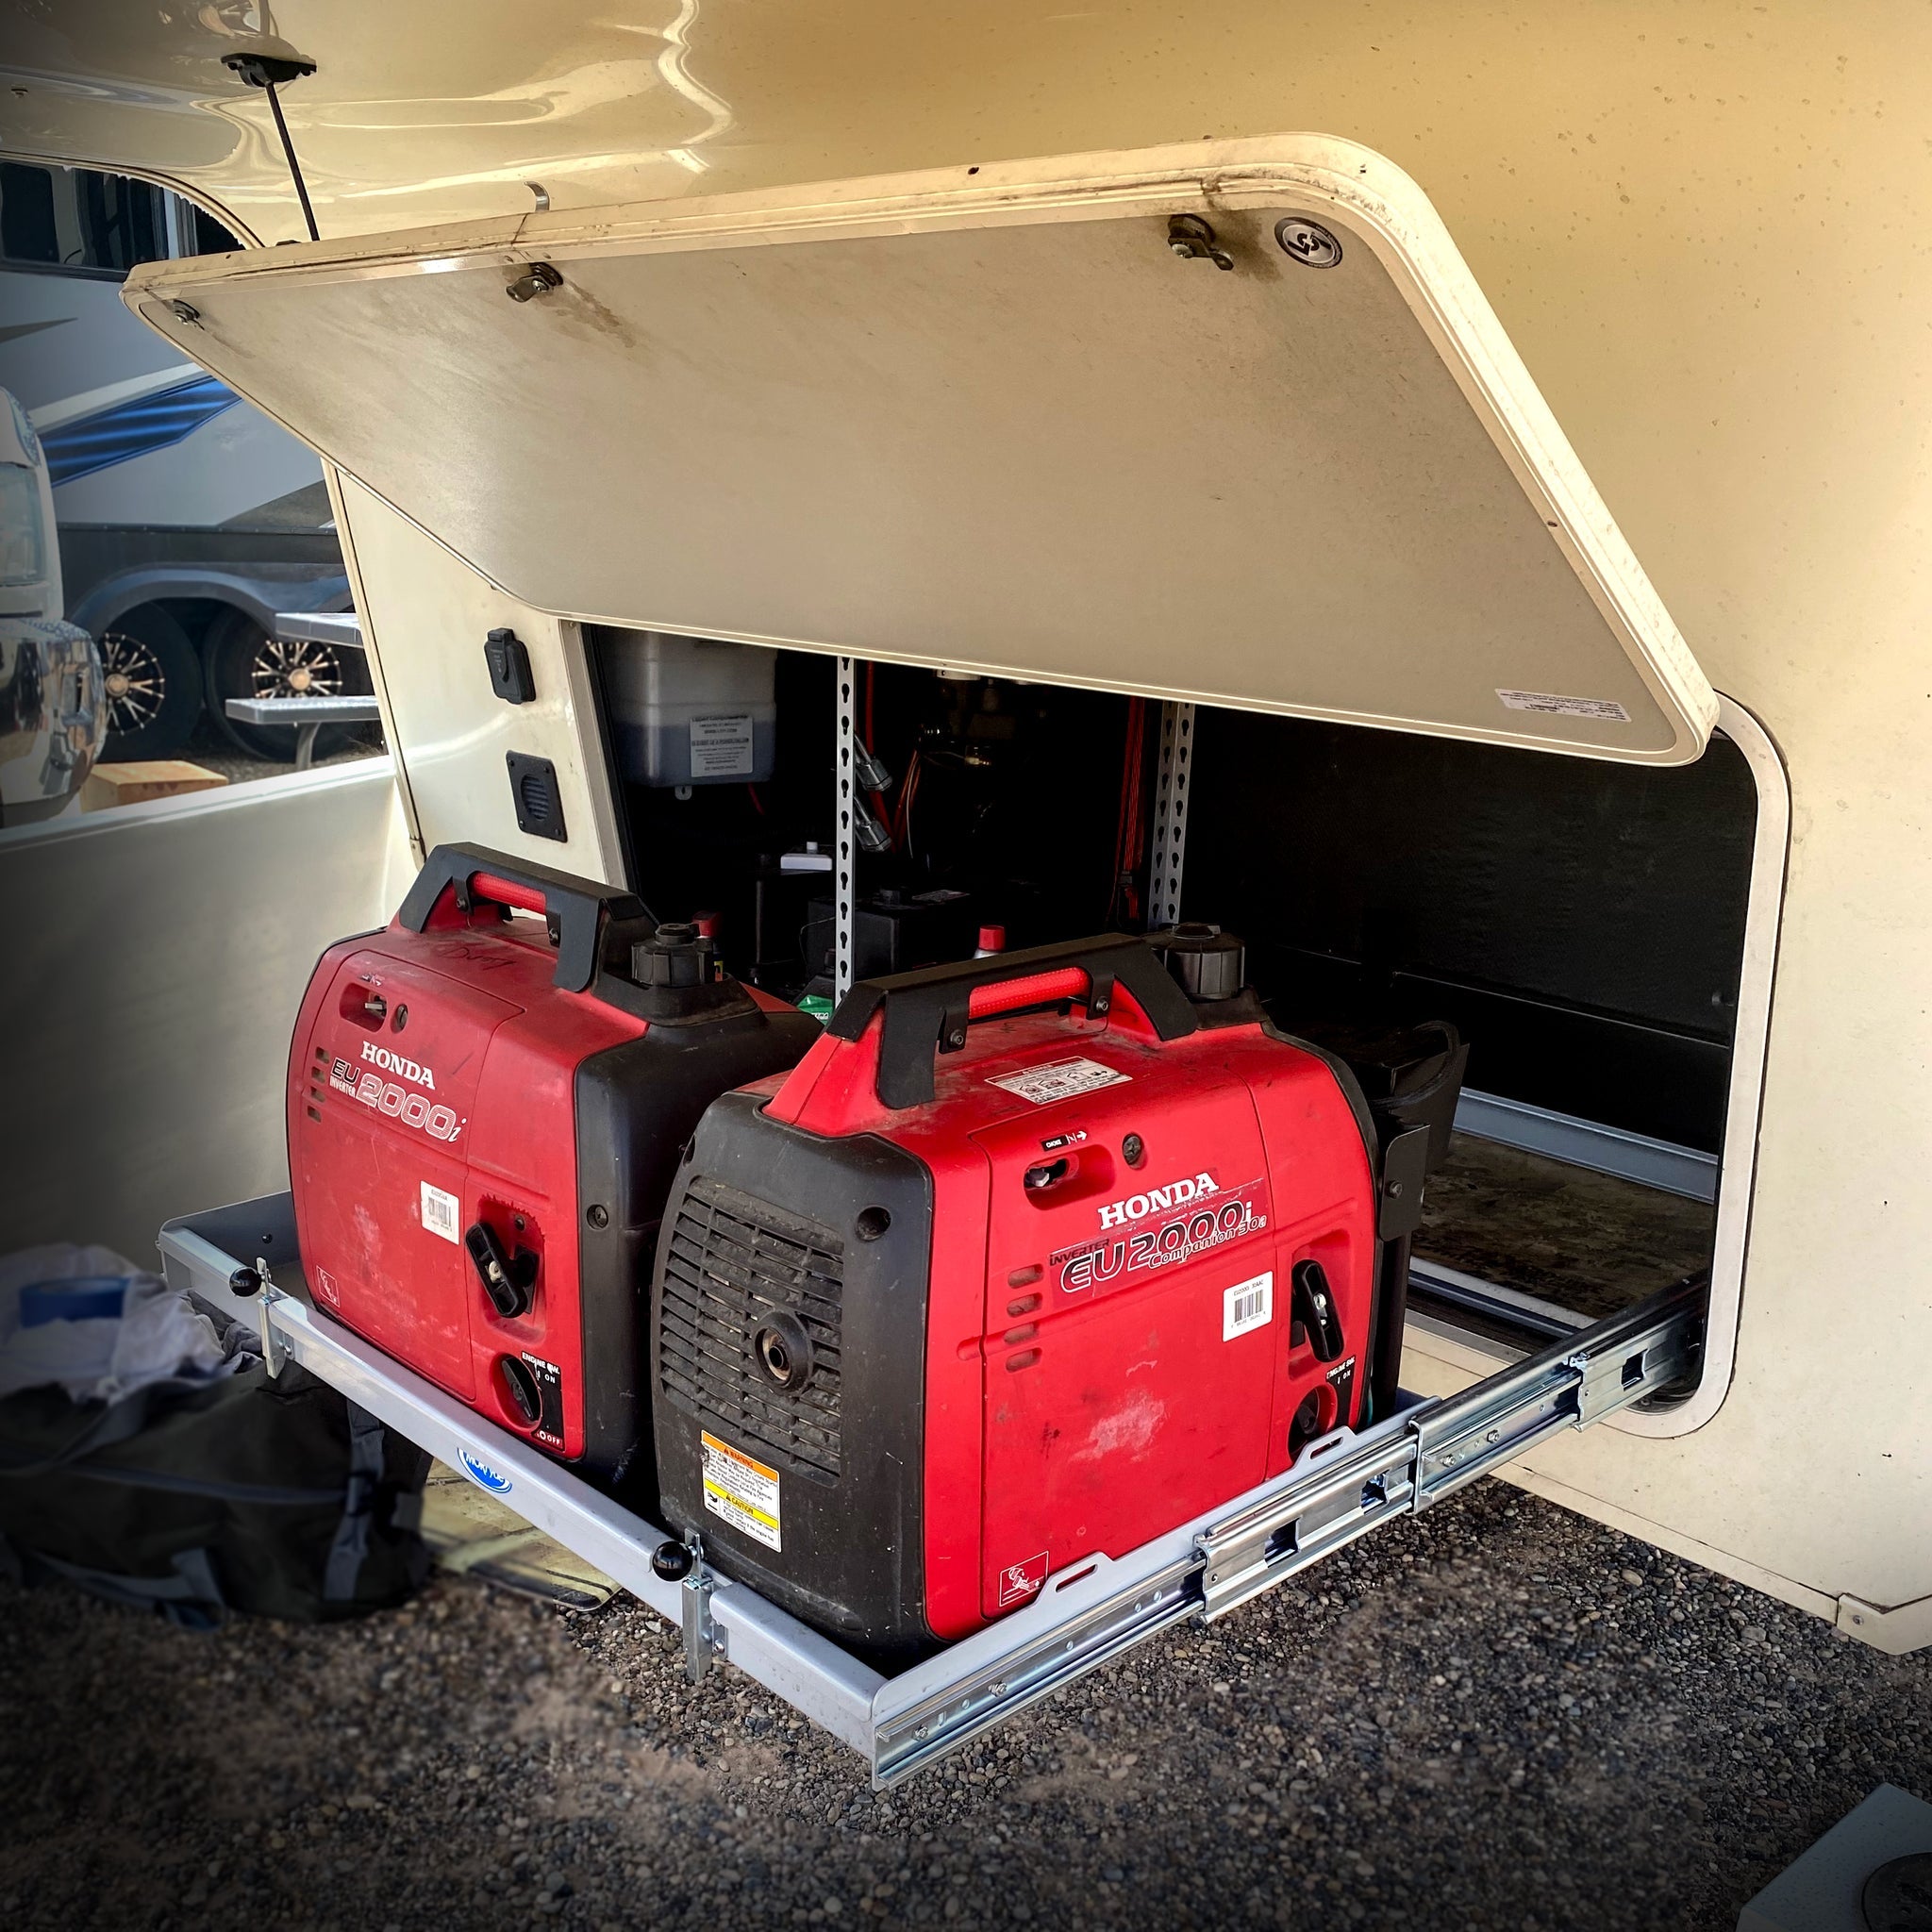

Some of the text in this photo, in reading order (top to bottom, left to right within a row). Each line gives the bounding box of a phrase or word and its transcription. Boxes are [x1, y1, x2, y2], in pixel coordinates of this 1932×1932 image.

[329, 1074, 357, 1098] INVERTER
[359, 1041, 436, 1091] HONDA
[1097, 1172, 1220, 1231] HONDA
[1148, 1227, 1236, 1270] Companion
[732, 1498, 754, 1515] CAUTION
